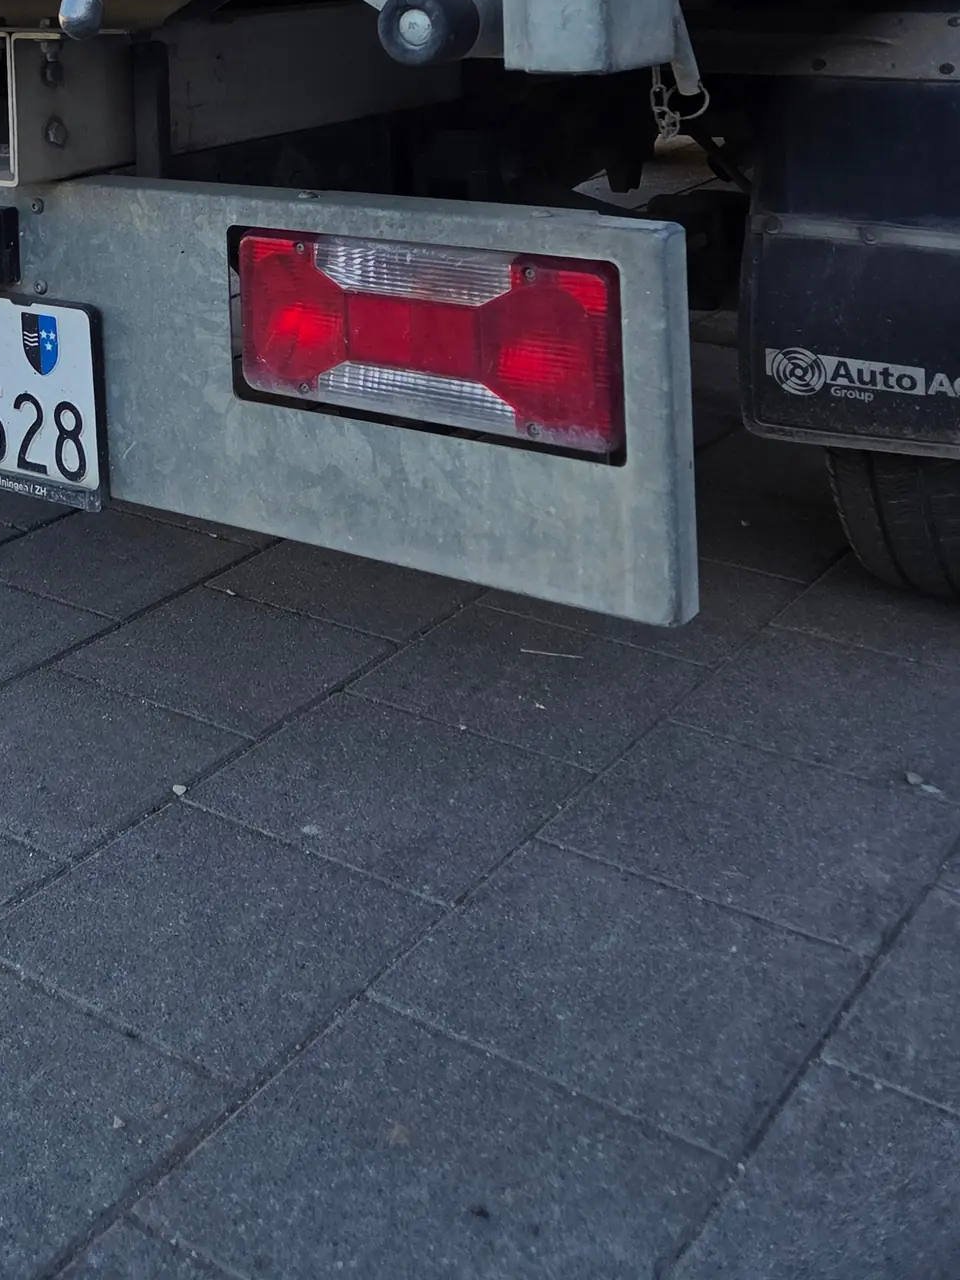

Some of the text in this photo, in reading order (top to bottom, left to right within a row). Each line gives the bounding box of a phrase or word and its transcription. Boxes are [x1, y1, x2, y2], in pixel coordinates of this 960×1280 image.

[830, 360, 960, 398] Auto A
[830, 386, 875, 403] Group
[34, 485, 48, 497] ZH
